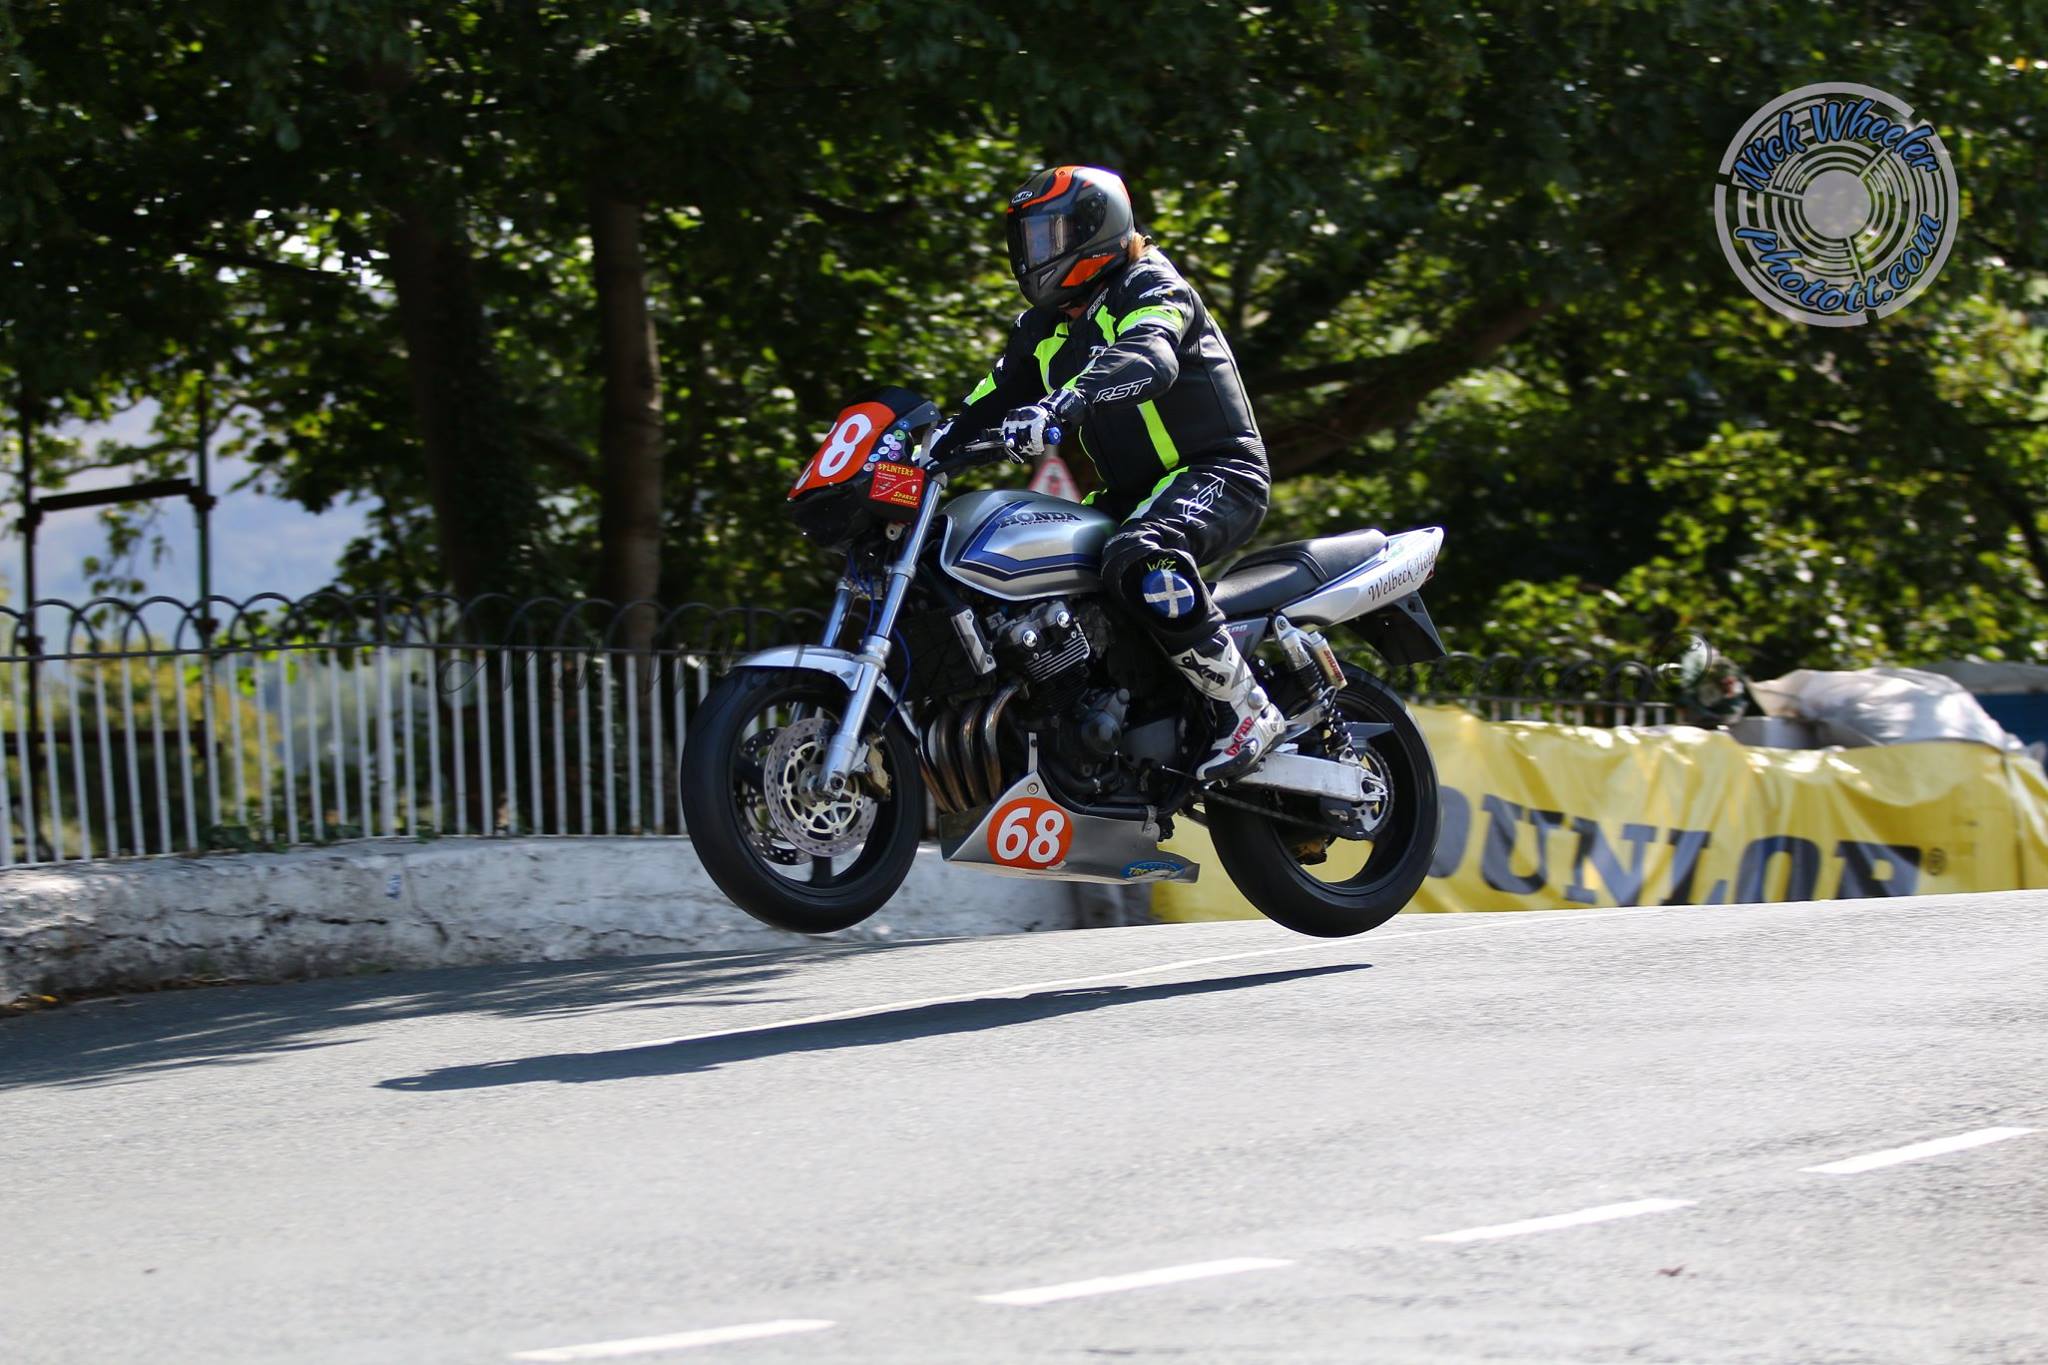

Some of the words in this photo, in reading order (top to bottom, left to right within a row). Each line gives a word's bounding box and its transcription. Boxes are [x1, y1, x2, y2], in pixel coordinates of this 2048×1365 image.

[1092, 377, 1153, 404] RST
[1000, 511, 1082, 528] HONDA
[1368, 560, 1414, 601] Welbeck
[996, 807, 1065, 863] 68
